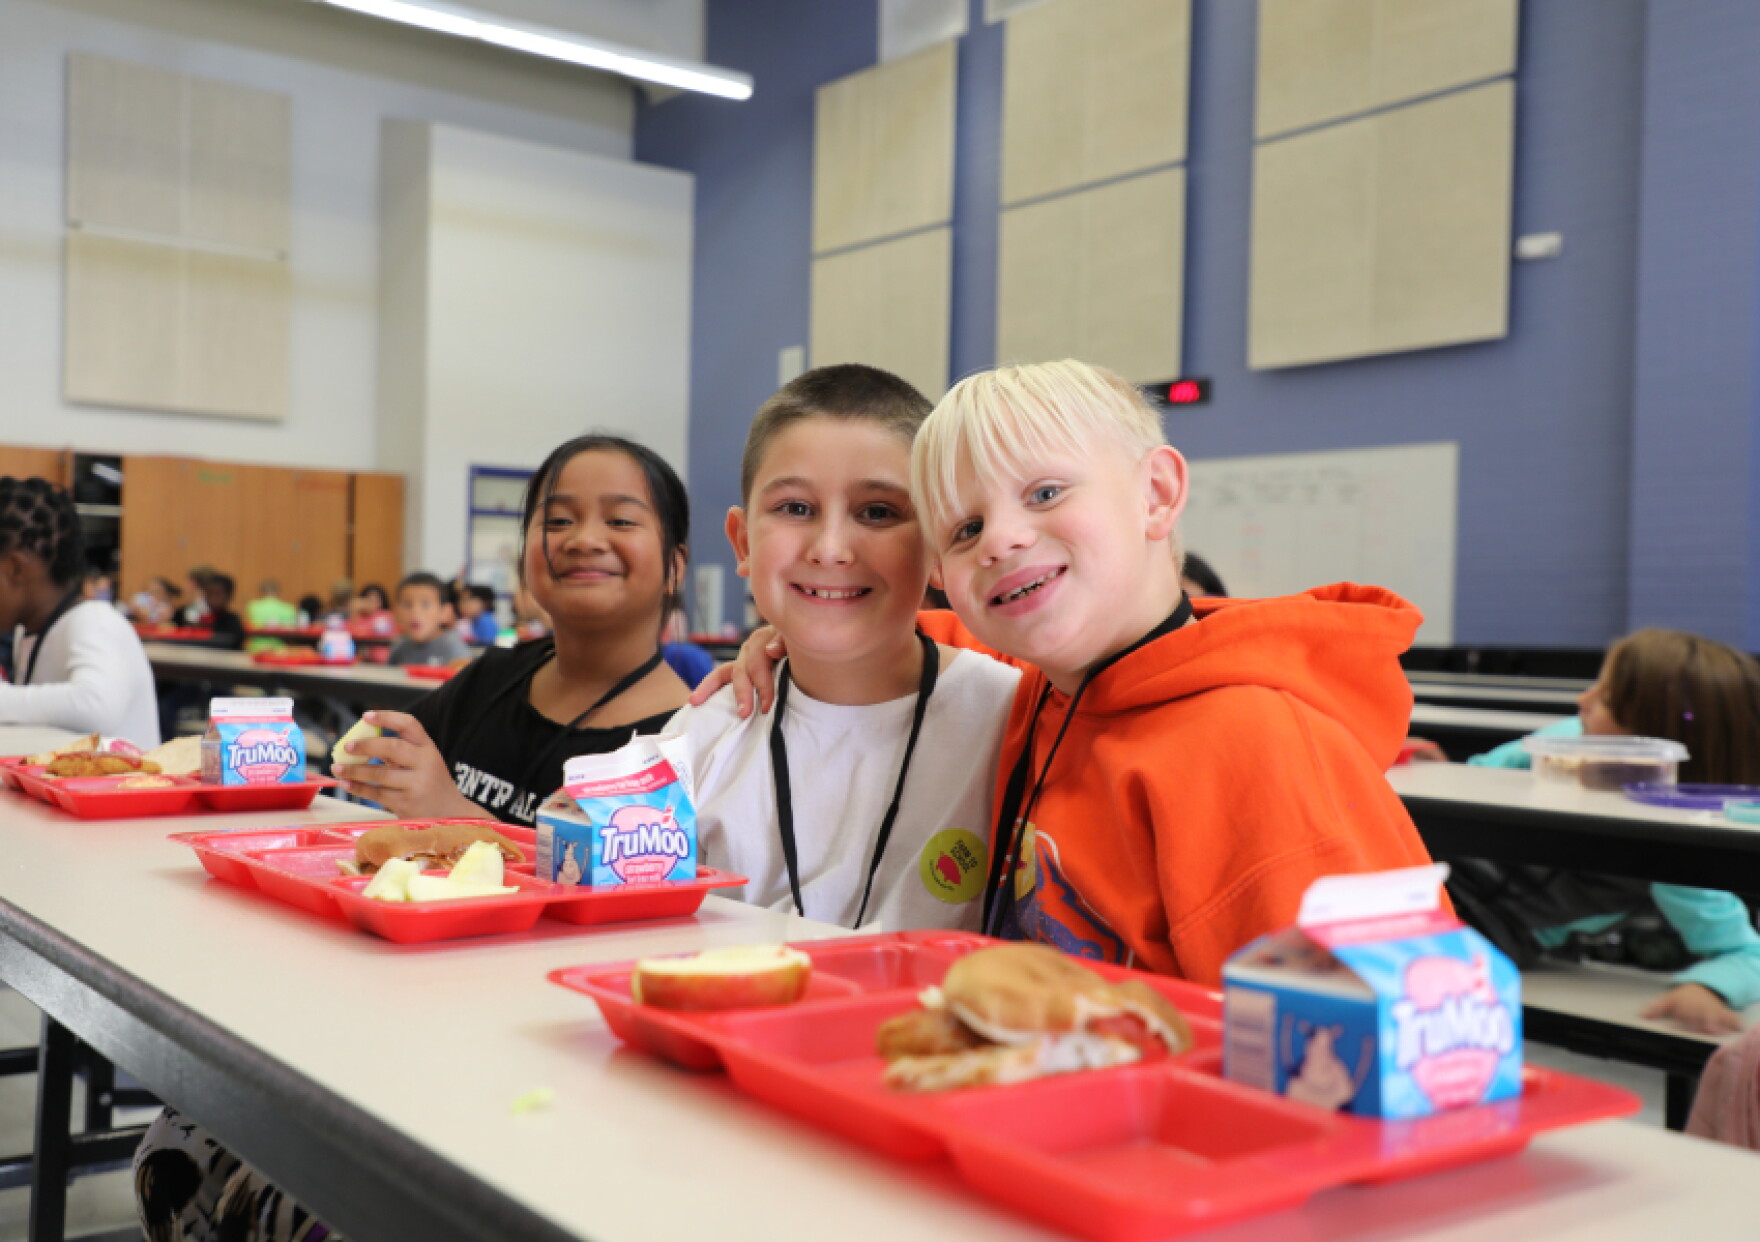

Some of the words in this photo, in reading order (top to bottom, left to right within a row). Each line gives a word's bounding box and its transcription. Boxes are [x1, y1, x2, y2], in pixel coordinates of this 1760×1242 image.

[226, 741, 298, 770] TruMoo
[599, 823, 689, 866] TruMoo
[1391, 992, 1513, 1071] TruMoo
